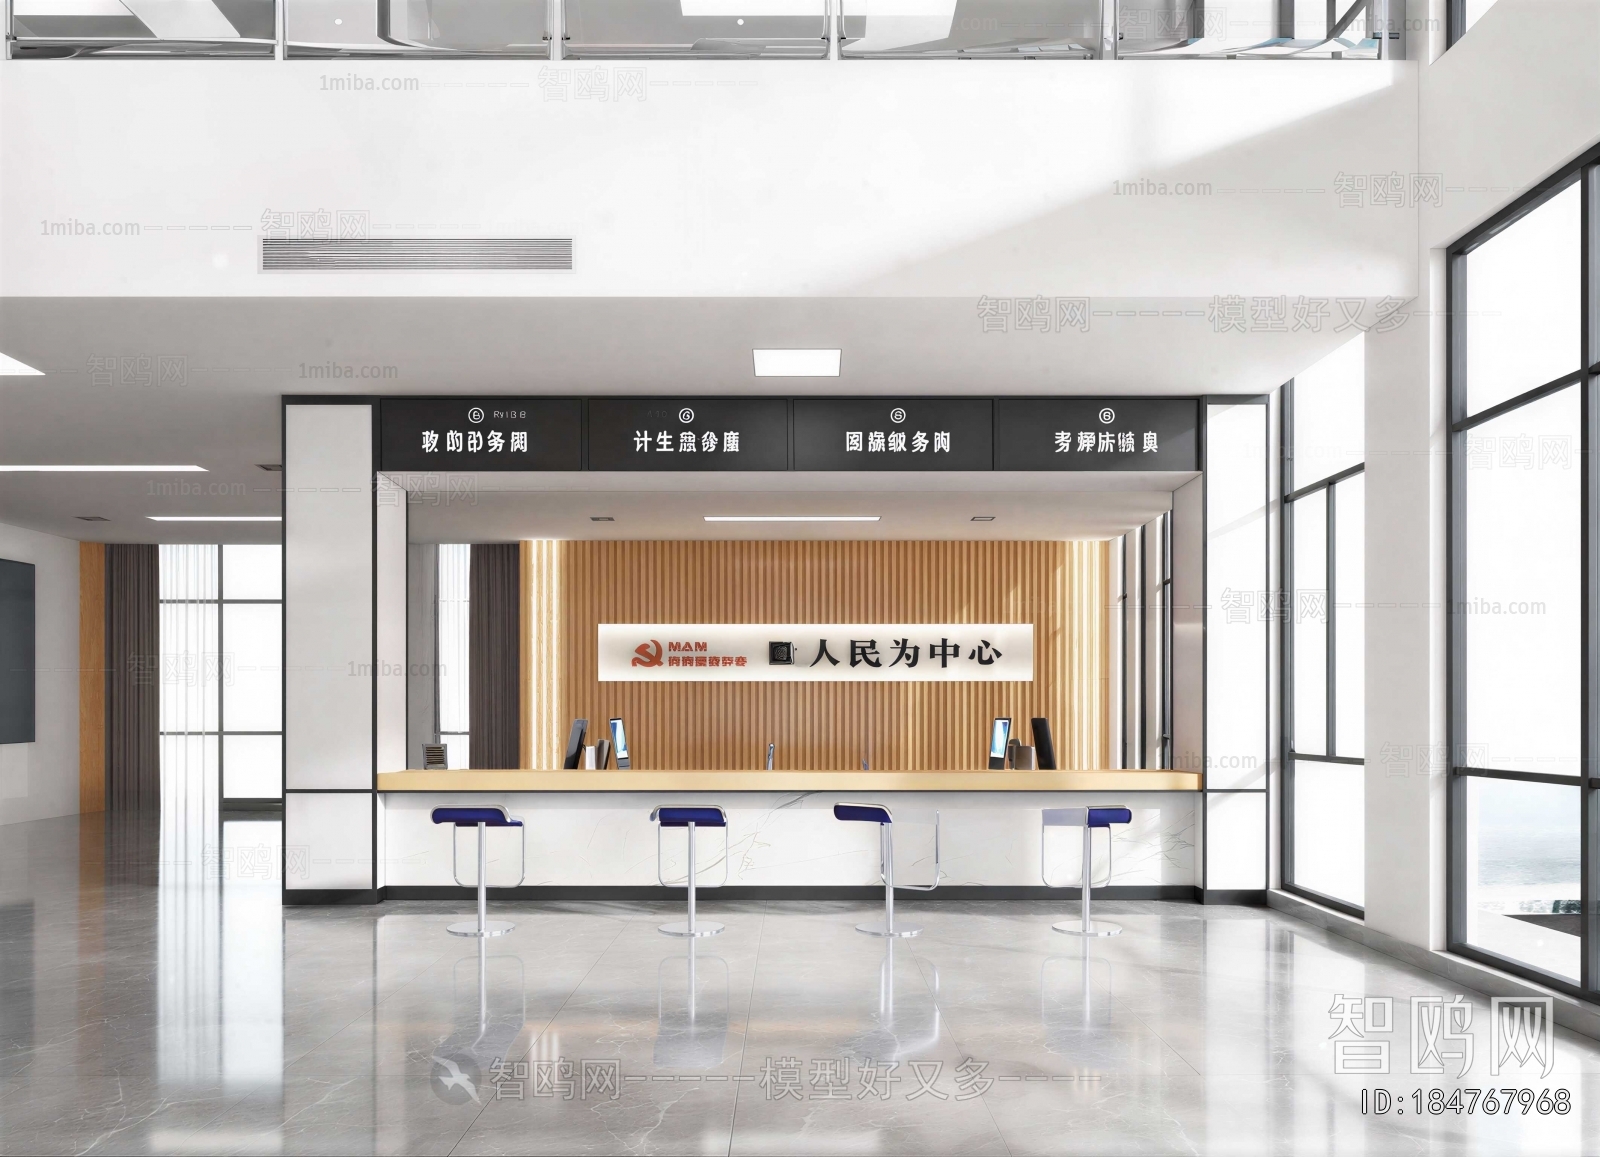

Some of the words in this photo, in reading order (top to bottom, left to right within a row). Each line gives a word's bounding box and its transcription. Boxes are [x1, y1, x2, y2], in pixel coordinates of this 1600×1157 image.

[810, 638, 1003, 669] 人民为中心
